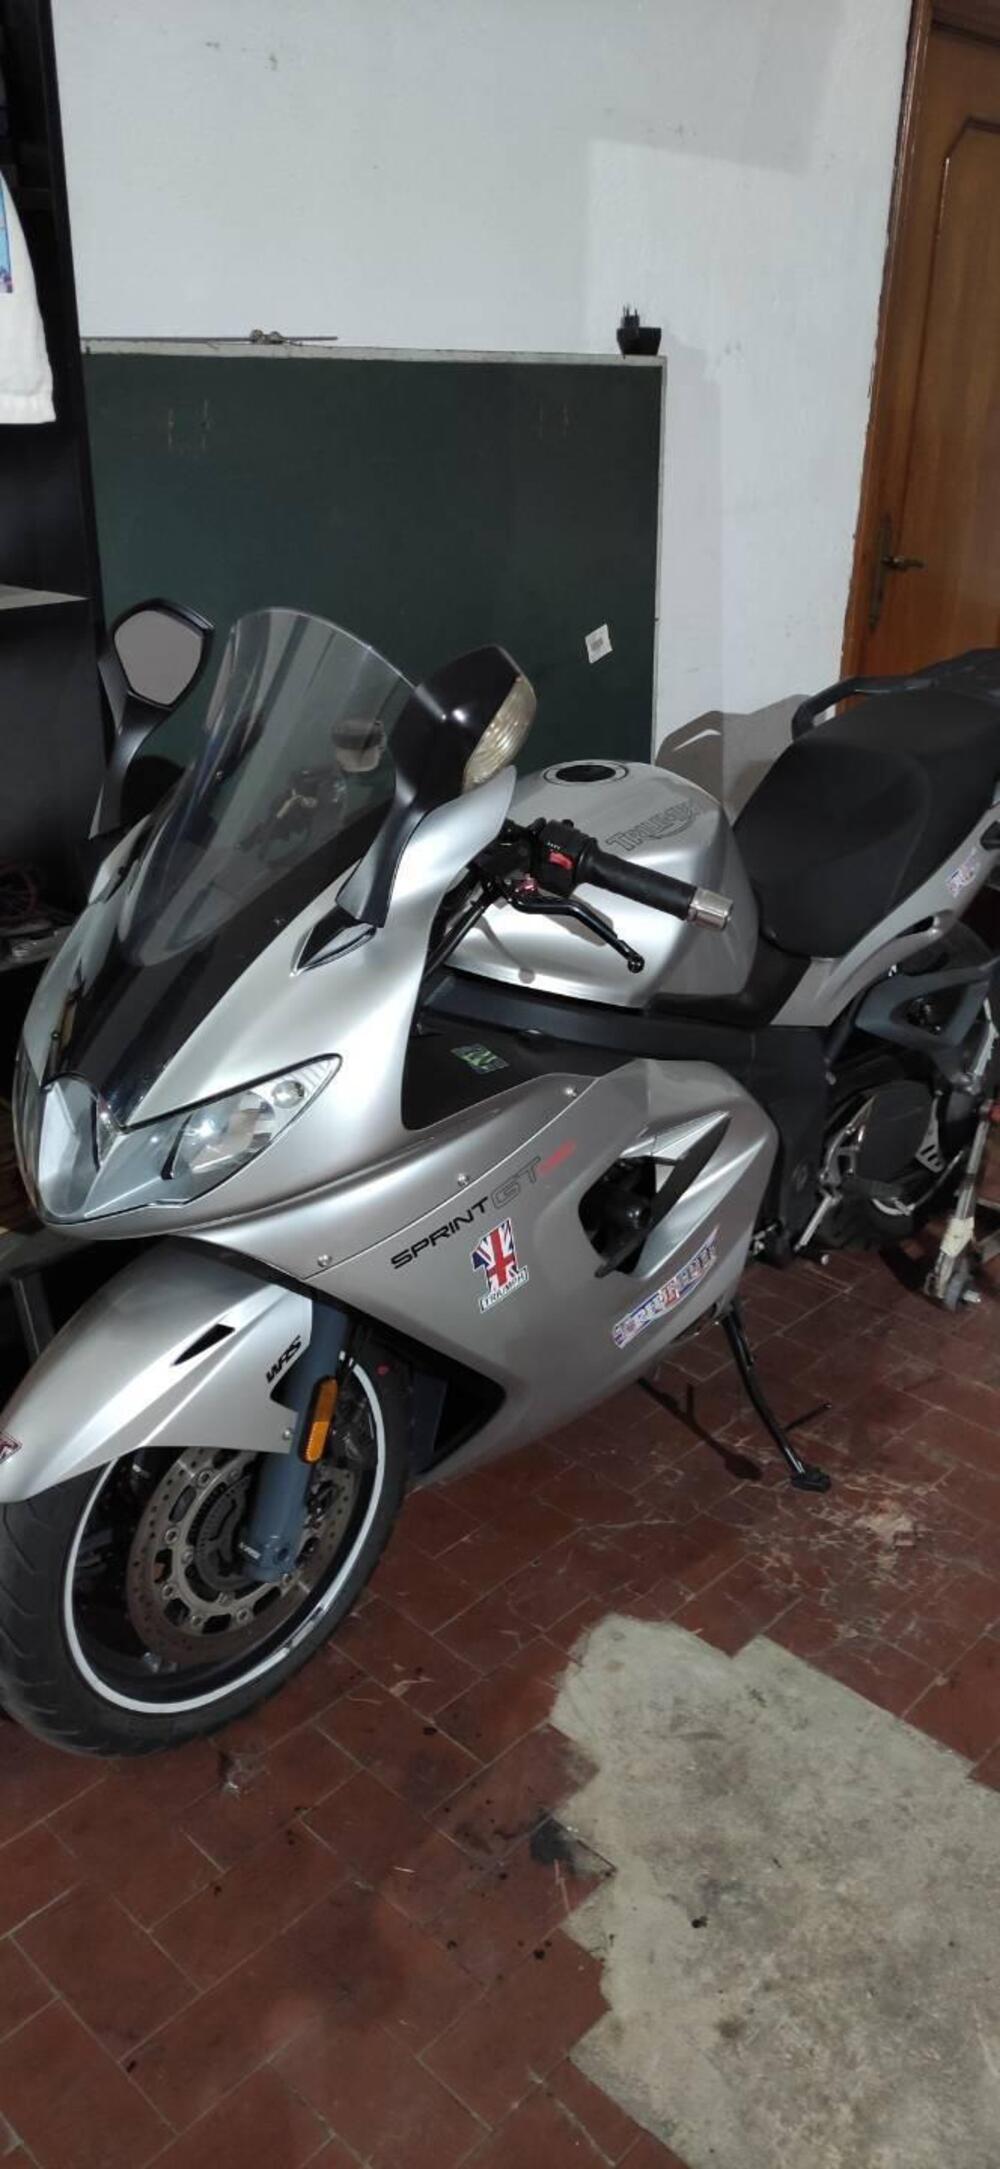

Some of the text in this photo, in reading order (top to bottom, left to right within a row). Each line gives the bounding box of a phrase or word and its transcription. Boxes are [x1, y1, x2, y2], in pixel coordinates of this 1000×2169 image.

[391, 1196, 489, 1269] SPRINT
[491, 1156, 541, 1209] GT
[266, 1334, 301, 1383] WRS
